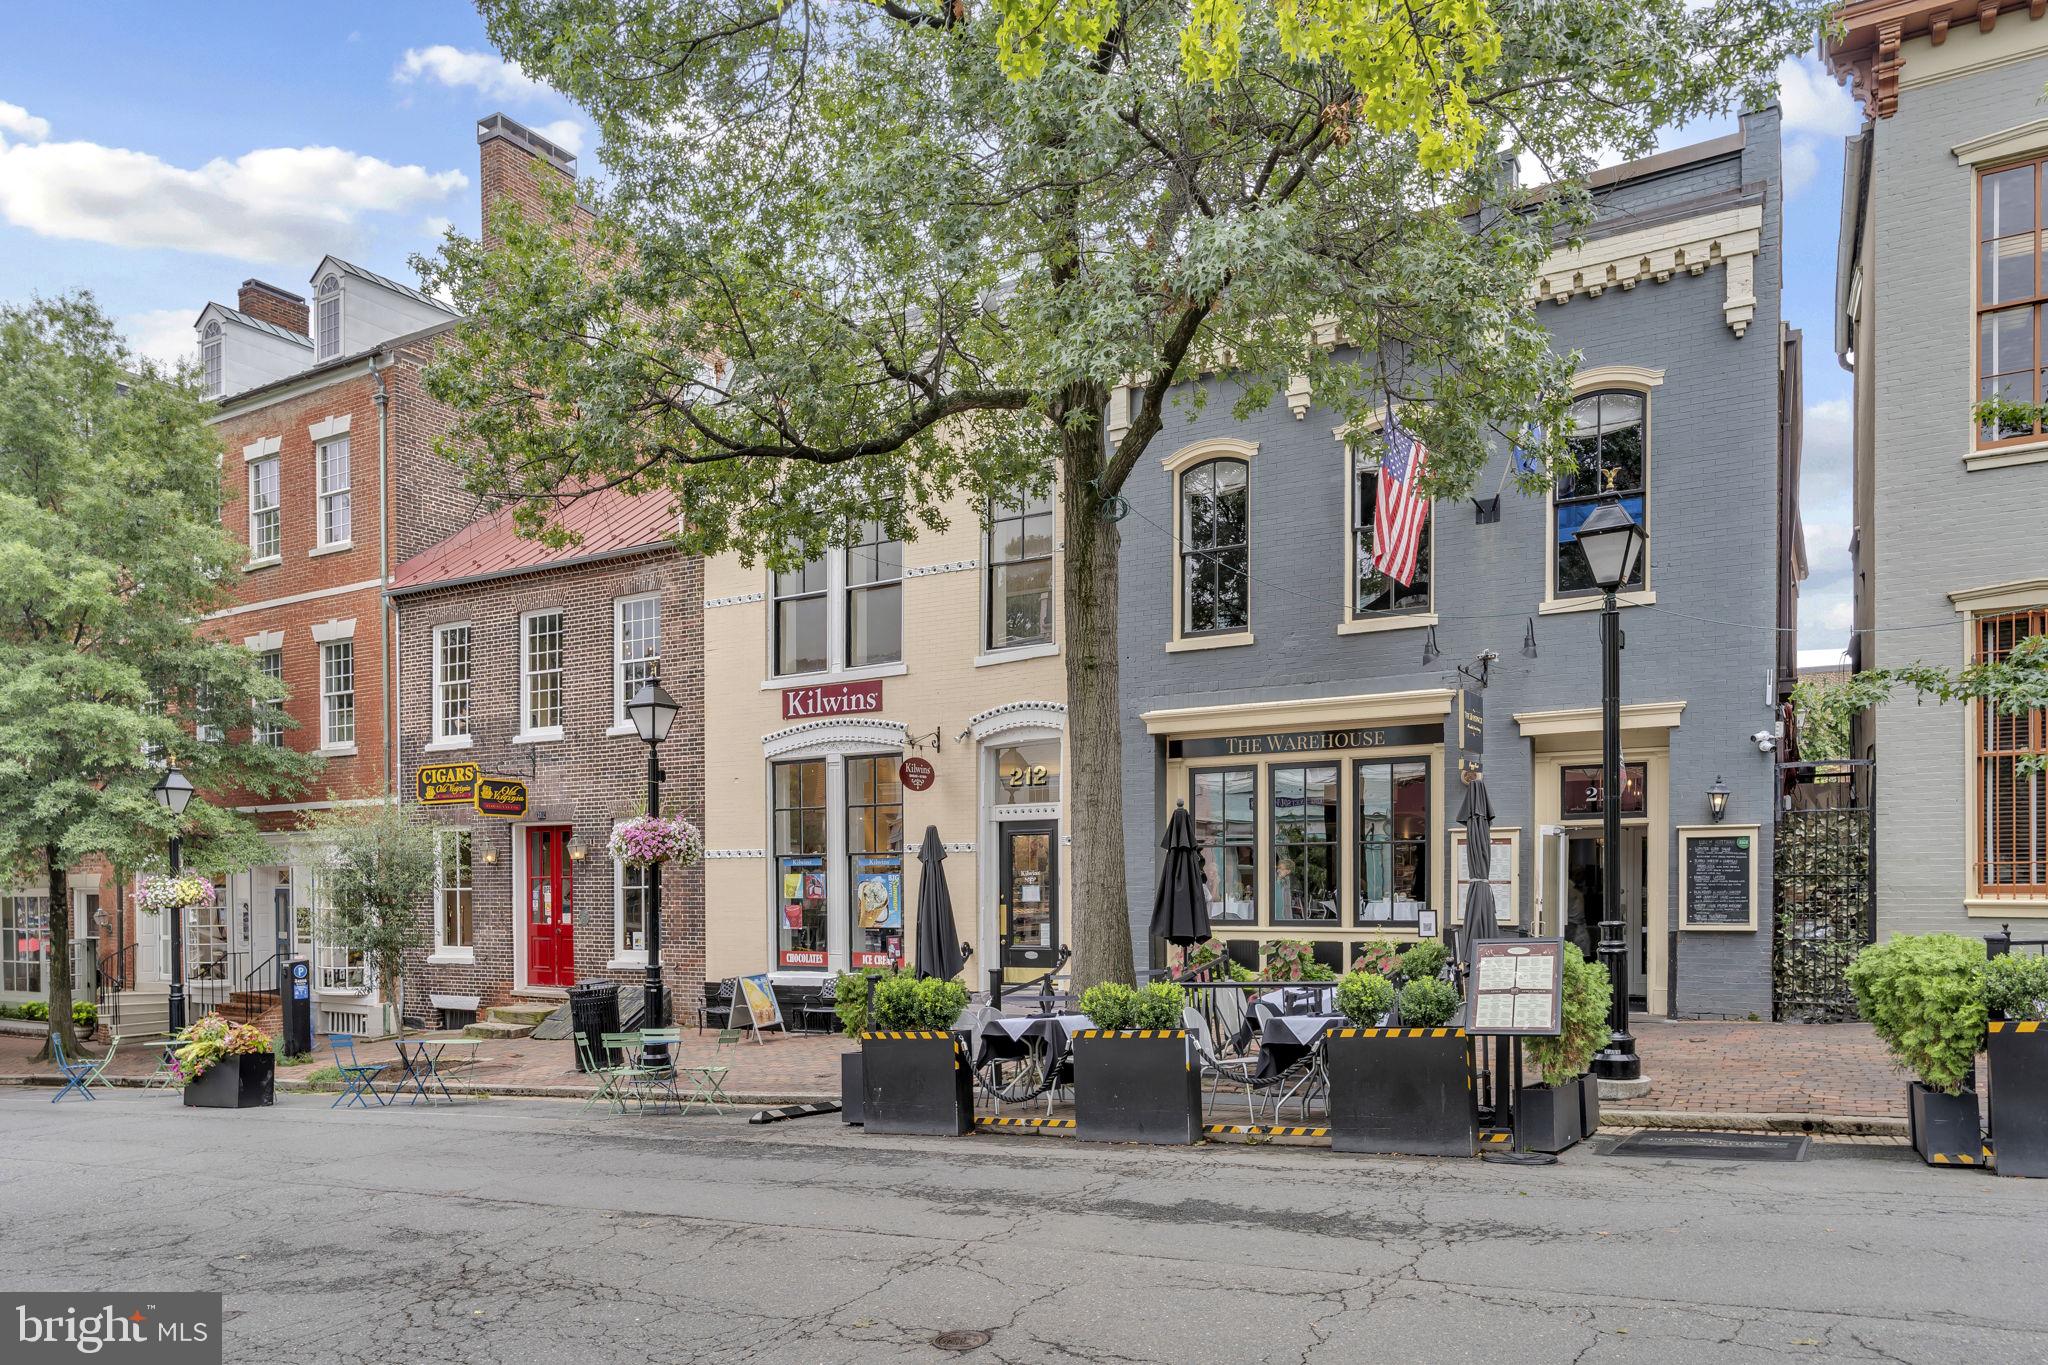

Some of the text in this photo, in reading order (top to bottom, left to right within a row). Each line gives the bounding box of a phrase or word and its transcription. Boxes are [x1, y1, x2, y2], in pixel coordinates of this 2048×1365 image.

[787, 686, 877, 717] Kilwins
[1226, 730, 1385, 754] THE WAREHOUSE
[422, 767, 474, 784] CIGARS
[905, 762, 931, 775] Kilwins
[1010, 765, 1048, 787] 212
[1585, 786, 1604, 802] 21
[786, 953, 823, 964] CHOCOLATES
[862, 954, 873, 965] ICE
